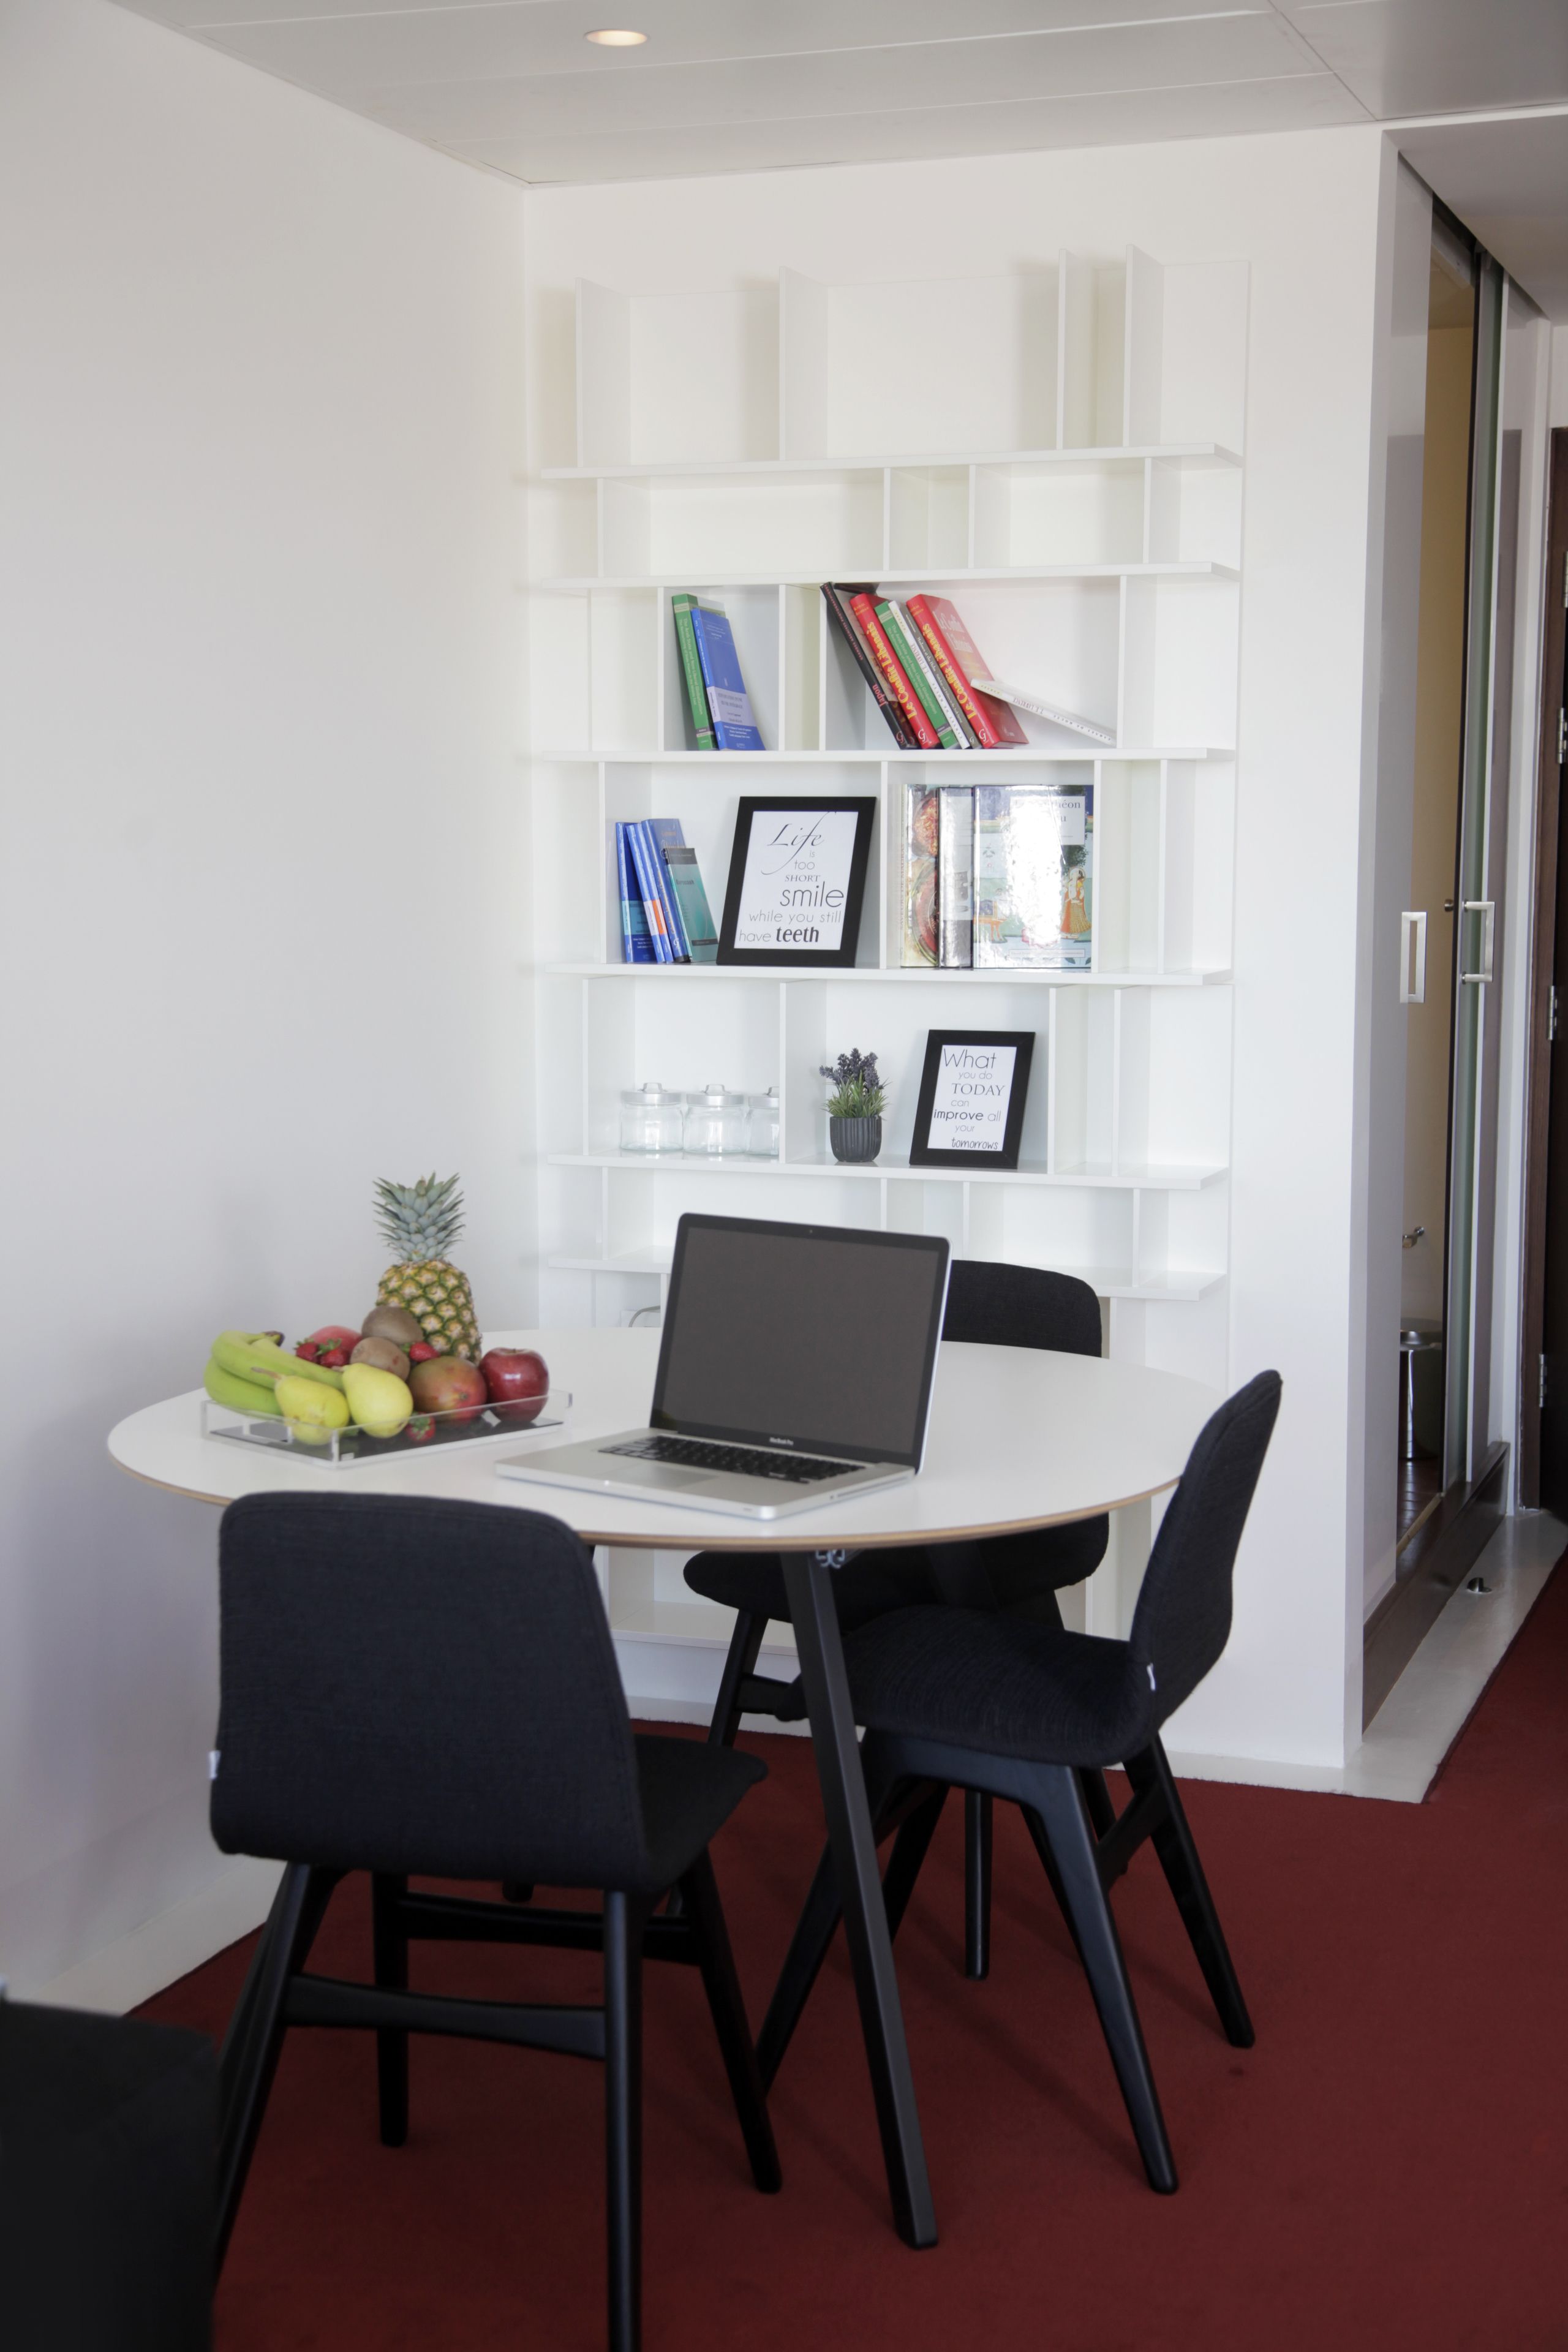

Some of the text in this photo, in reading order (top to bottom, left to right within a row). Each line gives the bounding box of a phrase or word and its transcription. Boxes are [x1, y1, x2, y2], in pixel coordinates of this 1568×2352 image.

[867, 622, 892, 666] Libanais
[922, 624, 977, 719] Le Conflit Libanais
[888, 665, 909, 704] Conflit
[872, 683, 888, 707] Japon
[906, 701, 918, 719] Le
[761, 812, 836, 875] Life
[794, 860, 815, 870] too
[780, 881, 844, 907] smile
[749, 910, 841, 924] while you still
[739, 926, 820, 943] have teeth
[944, 1048, 997, 1069] What
[959, 1071, 993, 1080] you do
[951, 1083, 1006, 1096] TODAY
[933, 1109, 1001, 1121] improve all
[951, 1137, 999, 1150] tomorrows
